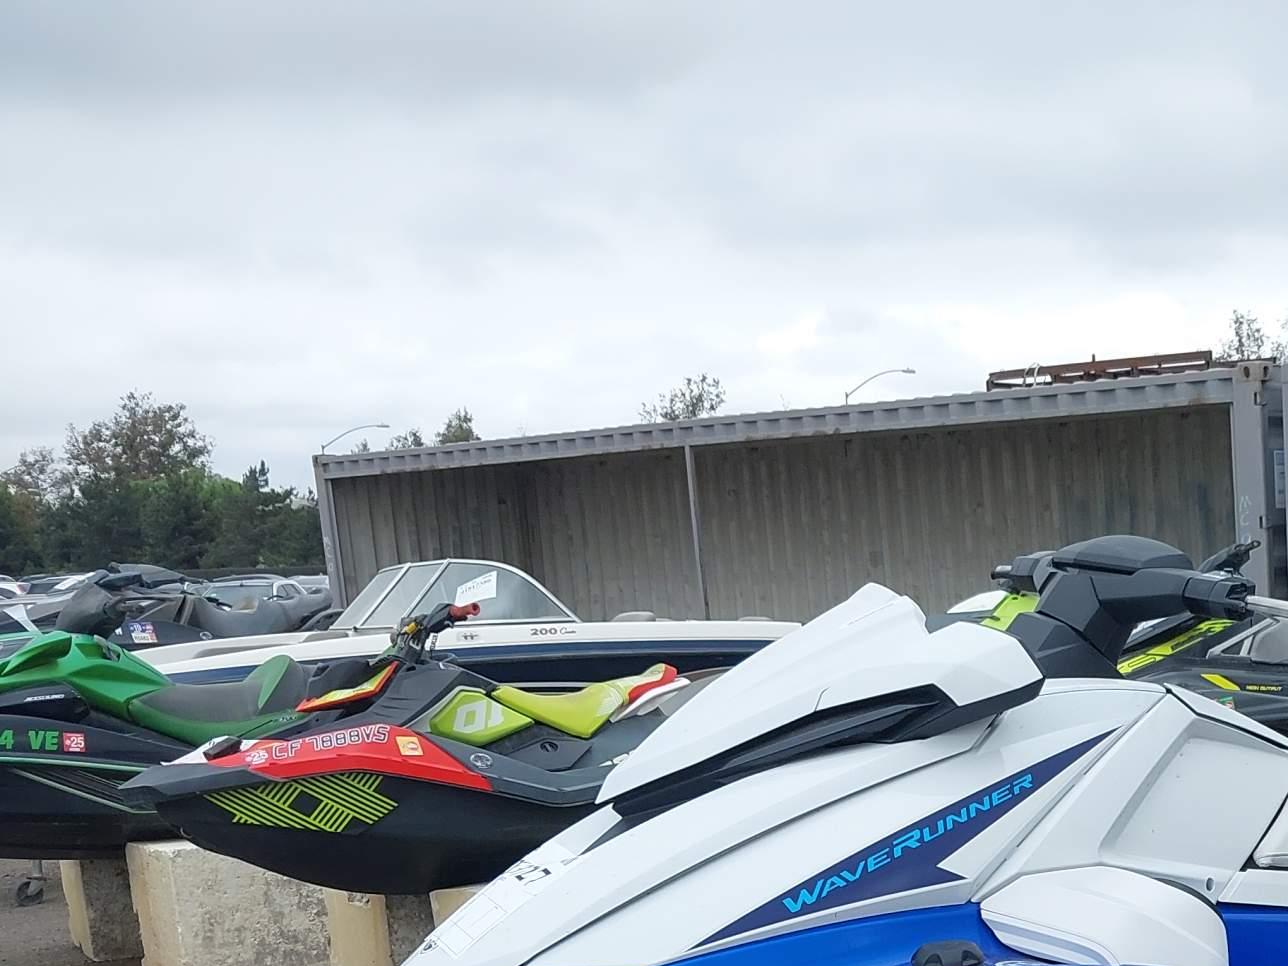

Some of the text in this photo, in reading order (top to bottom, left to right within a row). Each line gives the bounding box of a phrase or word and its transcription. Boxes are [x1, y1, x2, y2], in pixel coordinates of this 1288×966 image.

[530, 627, 558, 636] 200
[28, 731, 59, 751] VE
[70, 736, 85, 748] 25
[272, 739, 302, 760] CF
[782, 773, 1033, 913] WAVERUNNER
